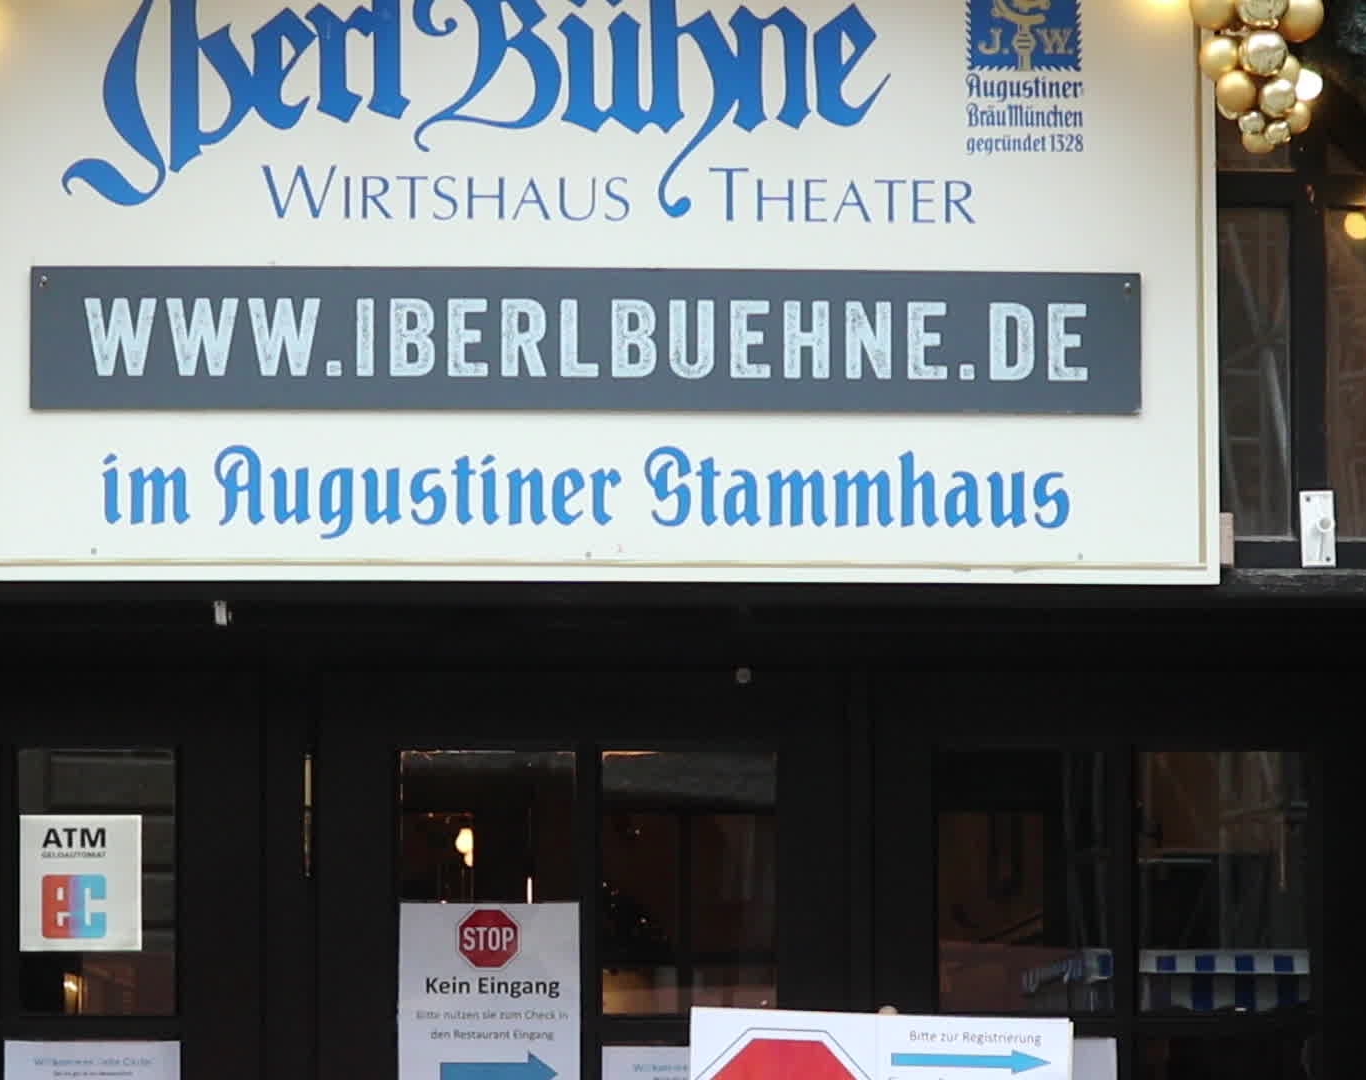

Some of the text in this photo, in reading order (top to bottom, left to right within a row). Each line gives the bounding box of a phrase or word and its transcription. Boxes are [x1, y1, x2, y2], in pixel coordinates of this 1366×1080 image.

[965, 72, 1083, 101] Augustiner
[414, 0, 891, 217] Bühne
[965, 102, 1083, 128] Bräu München
[966, 133, 1084, 156] gegründet 1328
[261, 164, 977, 224] WIRTSHAUS THEATER
[84, 297, 1089, 381] WWW.IBERLBUEHNE.DE
[102, 444, 1071, 540] im Augustiner Stammhaus
[42, 828, 106, 848] ATM
[463, 927, 515, 951] STOP
[426, 976, 560, 998] Kein Eingang
[443, 1009, 480, 1020] nutzen
[500, 1011, 523, 1020] zum
[525, 1009, 555, 1020] Check
[430, 1028, 554, 1041] den Restaurant Eingang
[909, 1030, 1041, 1047] Bitte zur Registrierung
